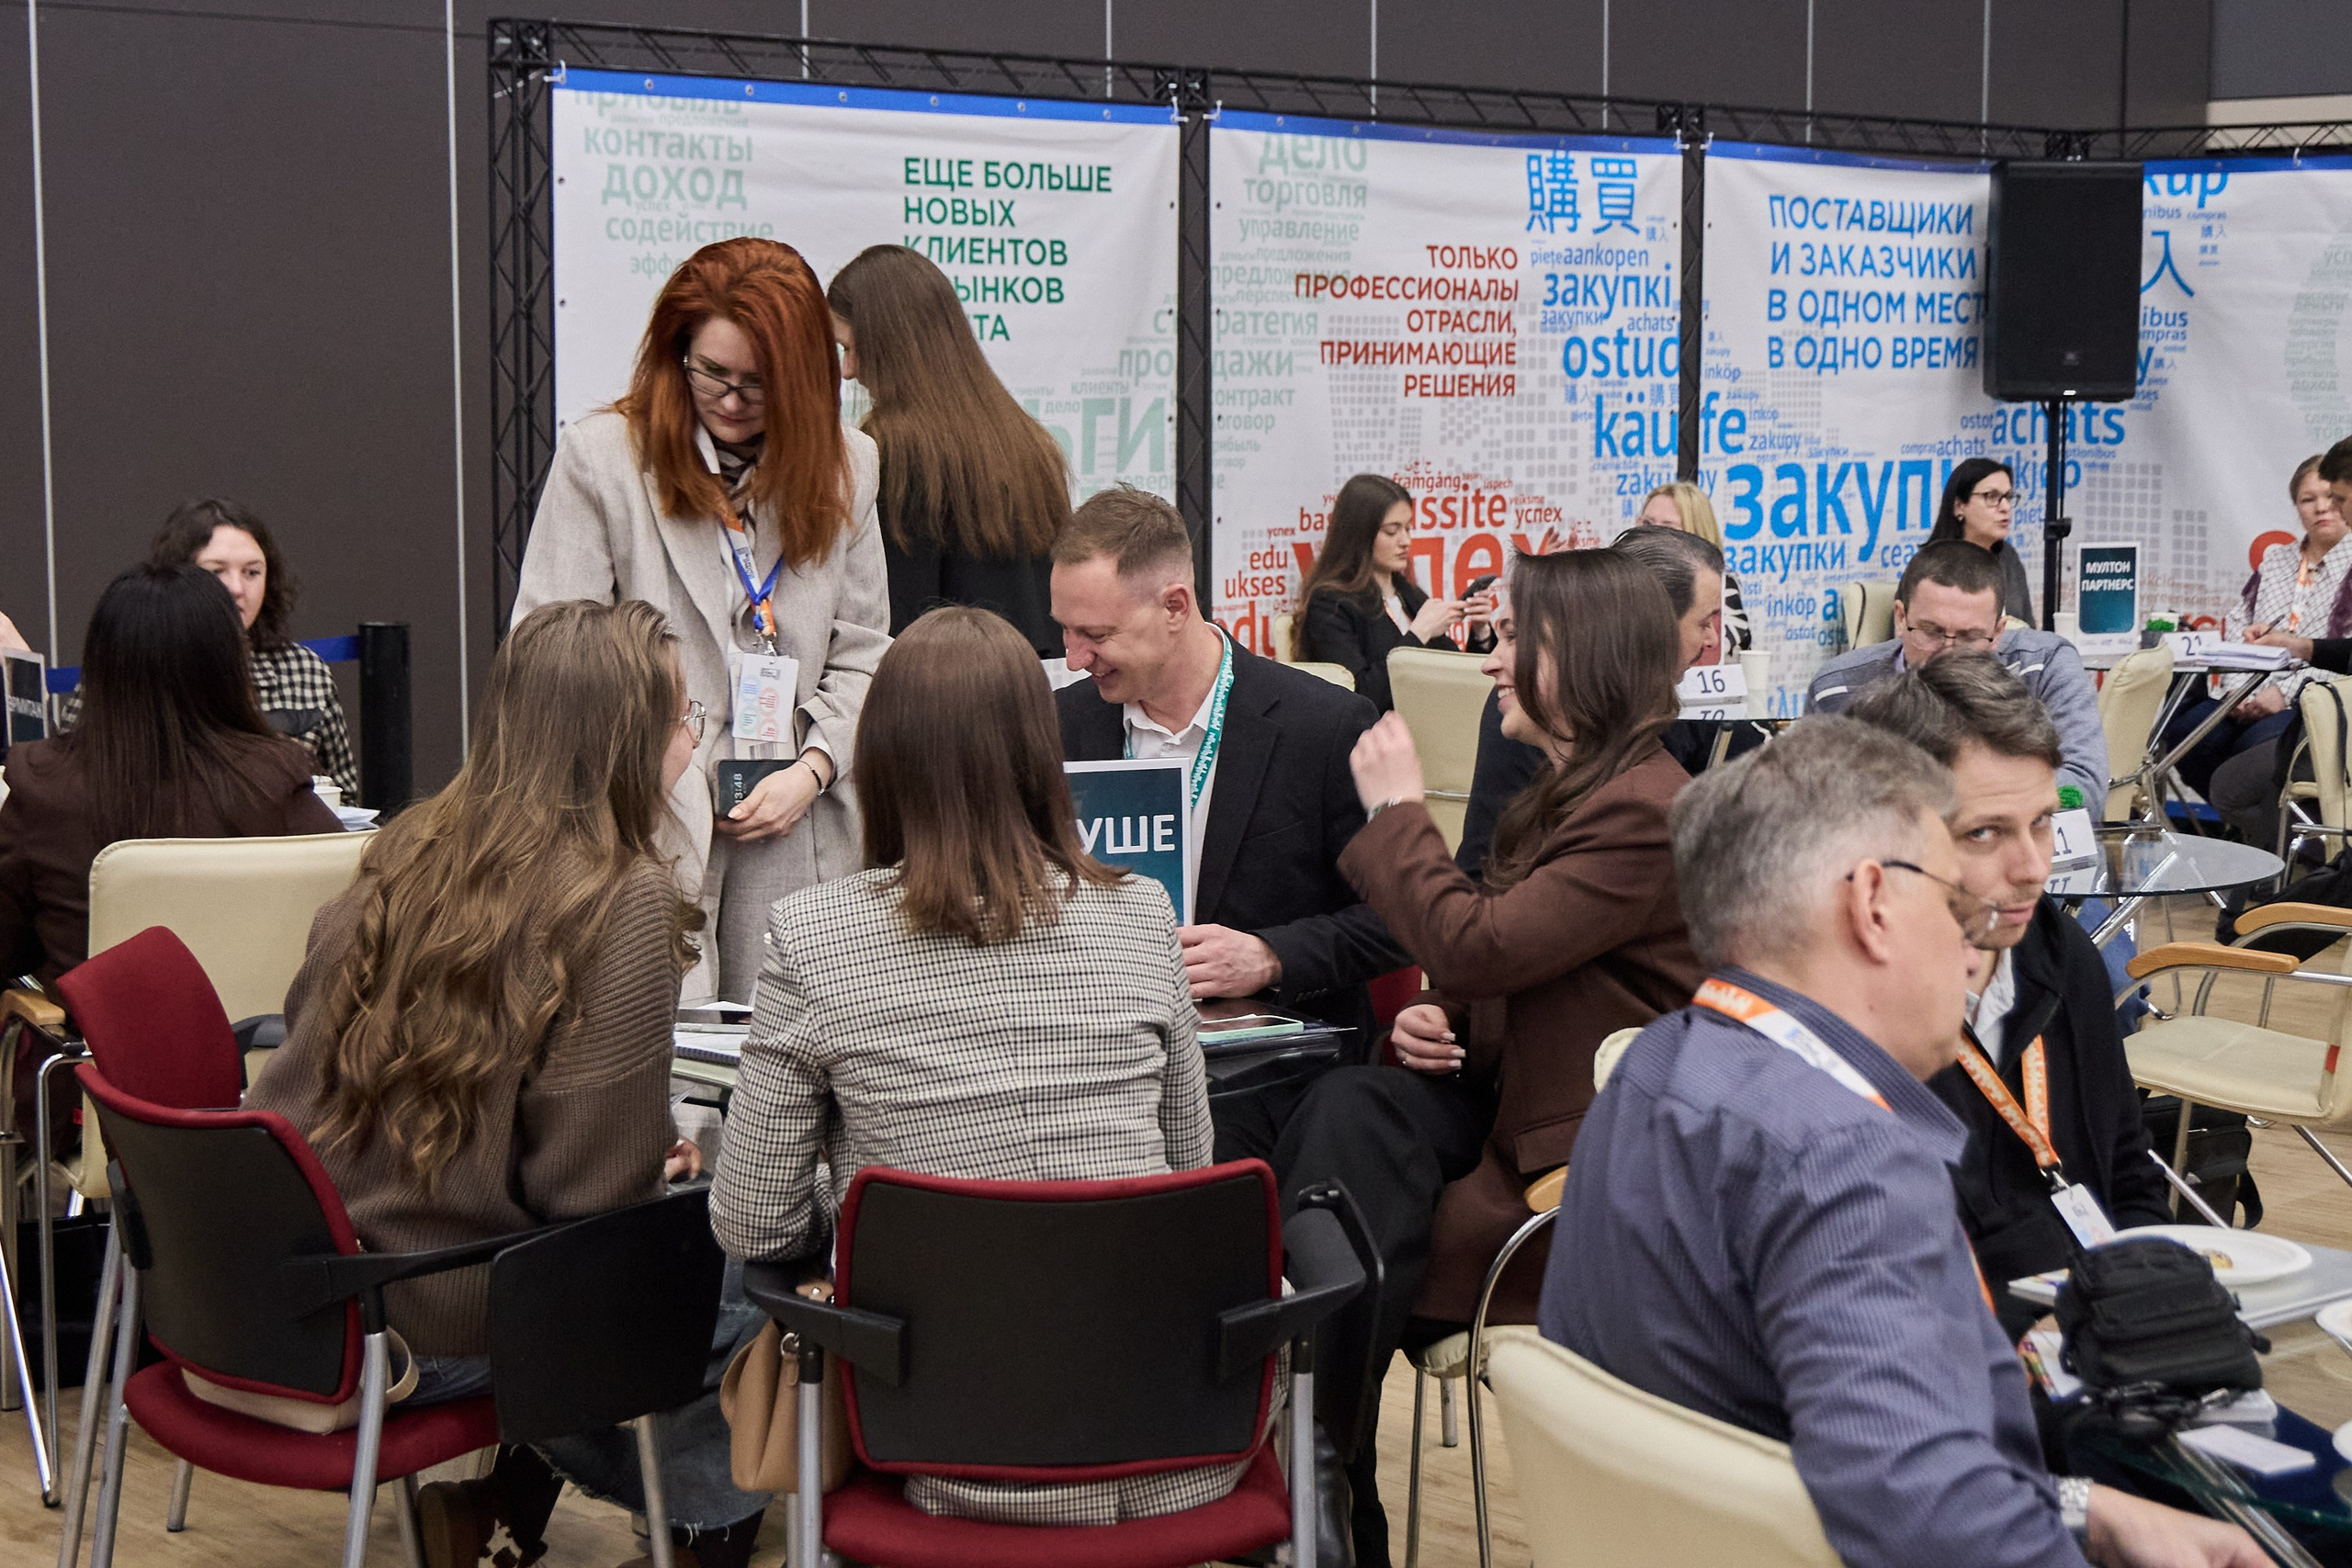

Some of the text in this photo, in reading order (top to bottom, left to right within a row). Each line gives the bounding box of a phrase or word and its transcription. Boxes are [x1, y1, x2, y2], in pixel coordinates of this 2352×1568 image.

[584, 127, 752, 163] контакты
[904, 157, 1112, 192] ЕЩЕ БОЛЬШЕ
[1244, 178, 1368, 212] торговля
[903, 196, 1015, 227] НОВЫХ
[1769, 194, 1973, 239] ПОСТАВЩИКИ
[605, 212, 774, 246] содействие
[1239, 218, 1360, 244] управление
[1426, 244, 1518, 269] ТОЛЬКО
[1564, 242, 1649, 272] aankopen
[1770, 241, 1976, 280] И ЗАКАЗЧИКИ
[954, 276, 1065, 304] ЫНКОВ
[1295, 274, 1519, 301] ПРОФЕССИОНАЛЫ
[1768, 288, 1986, 329] В ОДНОМ МЕСТ
[2143, 306, 2188, 328] ibus
[1407, 310, 1518, 337] ОТРАСЛИ,
[1320, 341, 1517, 370] ПРИНИМАЮЩИЕ
[1768, 335, 1980, 376] В ОДНО ВРЕМЯ
[1404, 374, 1516, 398] РЕШЕНИЯ
[1748, 430, 1802, 456] zakupy
[1936, 434, 1985, 457] achats
[1514, 506, 1562, 530] успех
[1724, 458, 1953, 563] закуп
[1267, 526, 1295, 539] успех
[1250, 544, 1288, 570] edu
[1724, 540, 1846, 584] закупки
[2086, 560, 2131, 574] МУЛТОН
[1225, 570, 1286, 599] ukses
[2081, 578, 2134, 592] ПАРТНЕРС
[1766, 591, 1816, 621] inköp
[1697, 670, 1725, 694] 16
[1078, 814, 1176, 856] УШЕ
